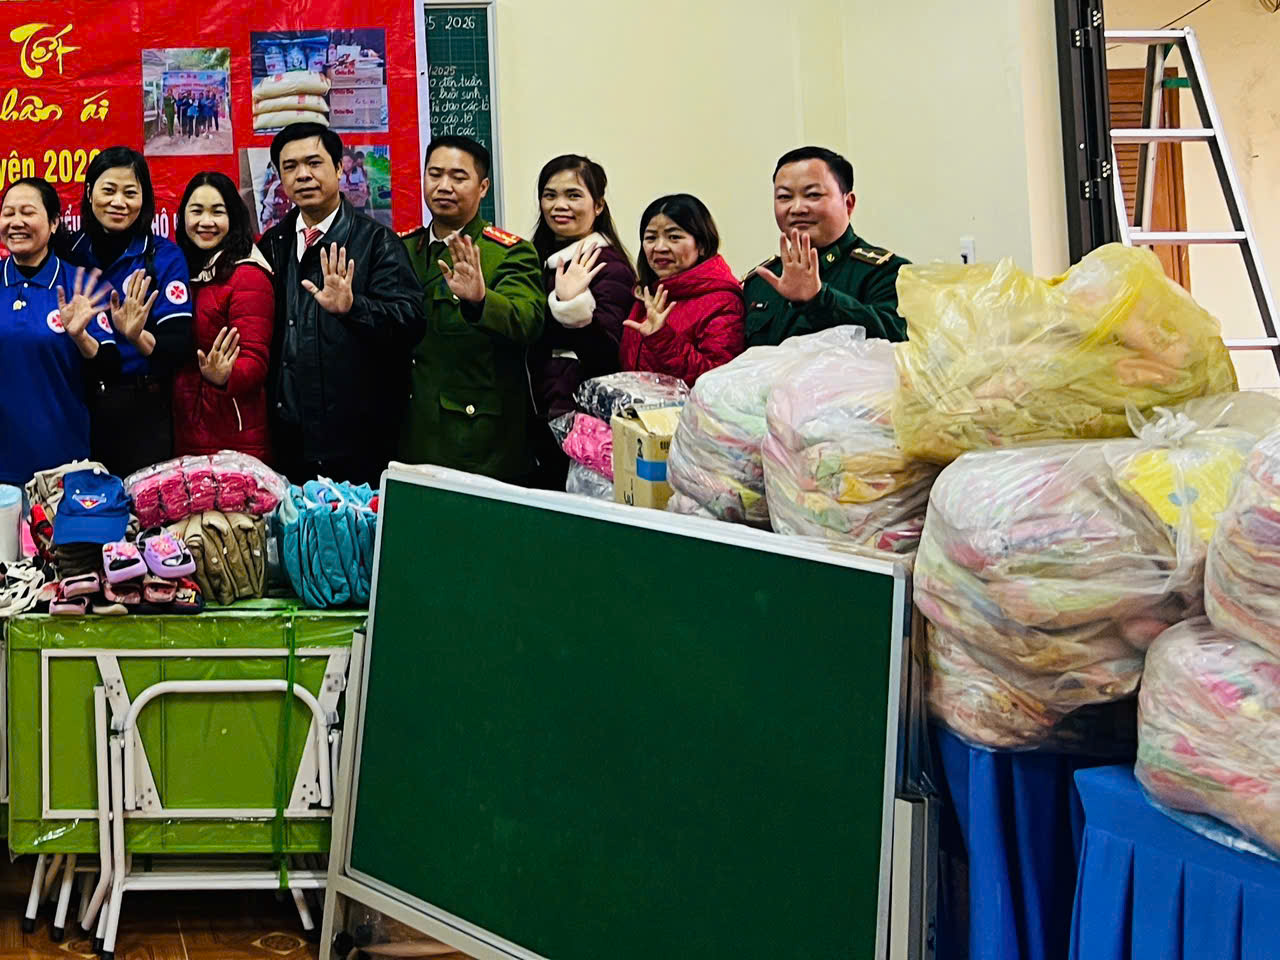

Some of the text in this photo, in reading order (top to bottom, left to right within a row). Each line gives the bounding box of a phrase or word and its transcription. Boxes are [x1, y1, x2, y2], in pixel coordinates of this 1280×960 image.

[445, 16, 476, 30] 2026
[9, 23, 82, 78] Tết
[80, 89, 110, 123] ái
